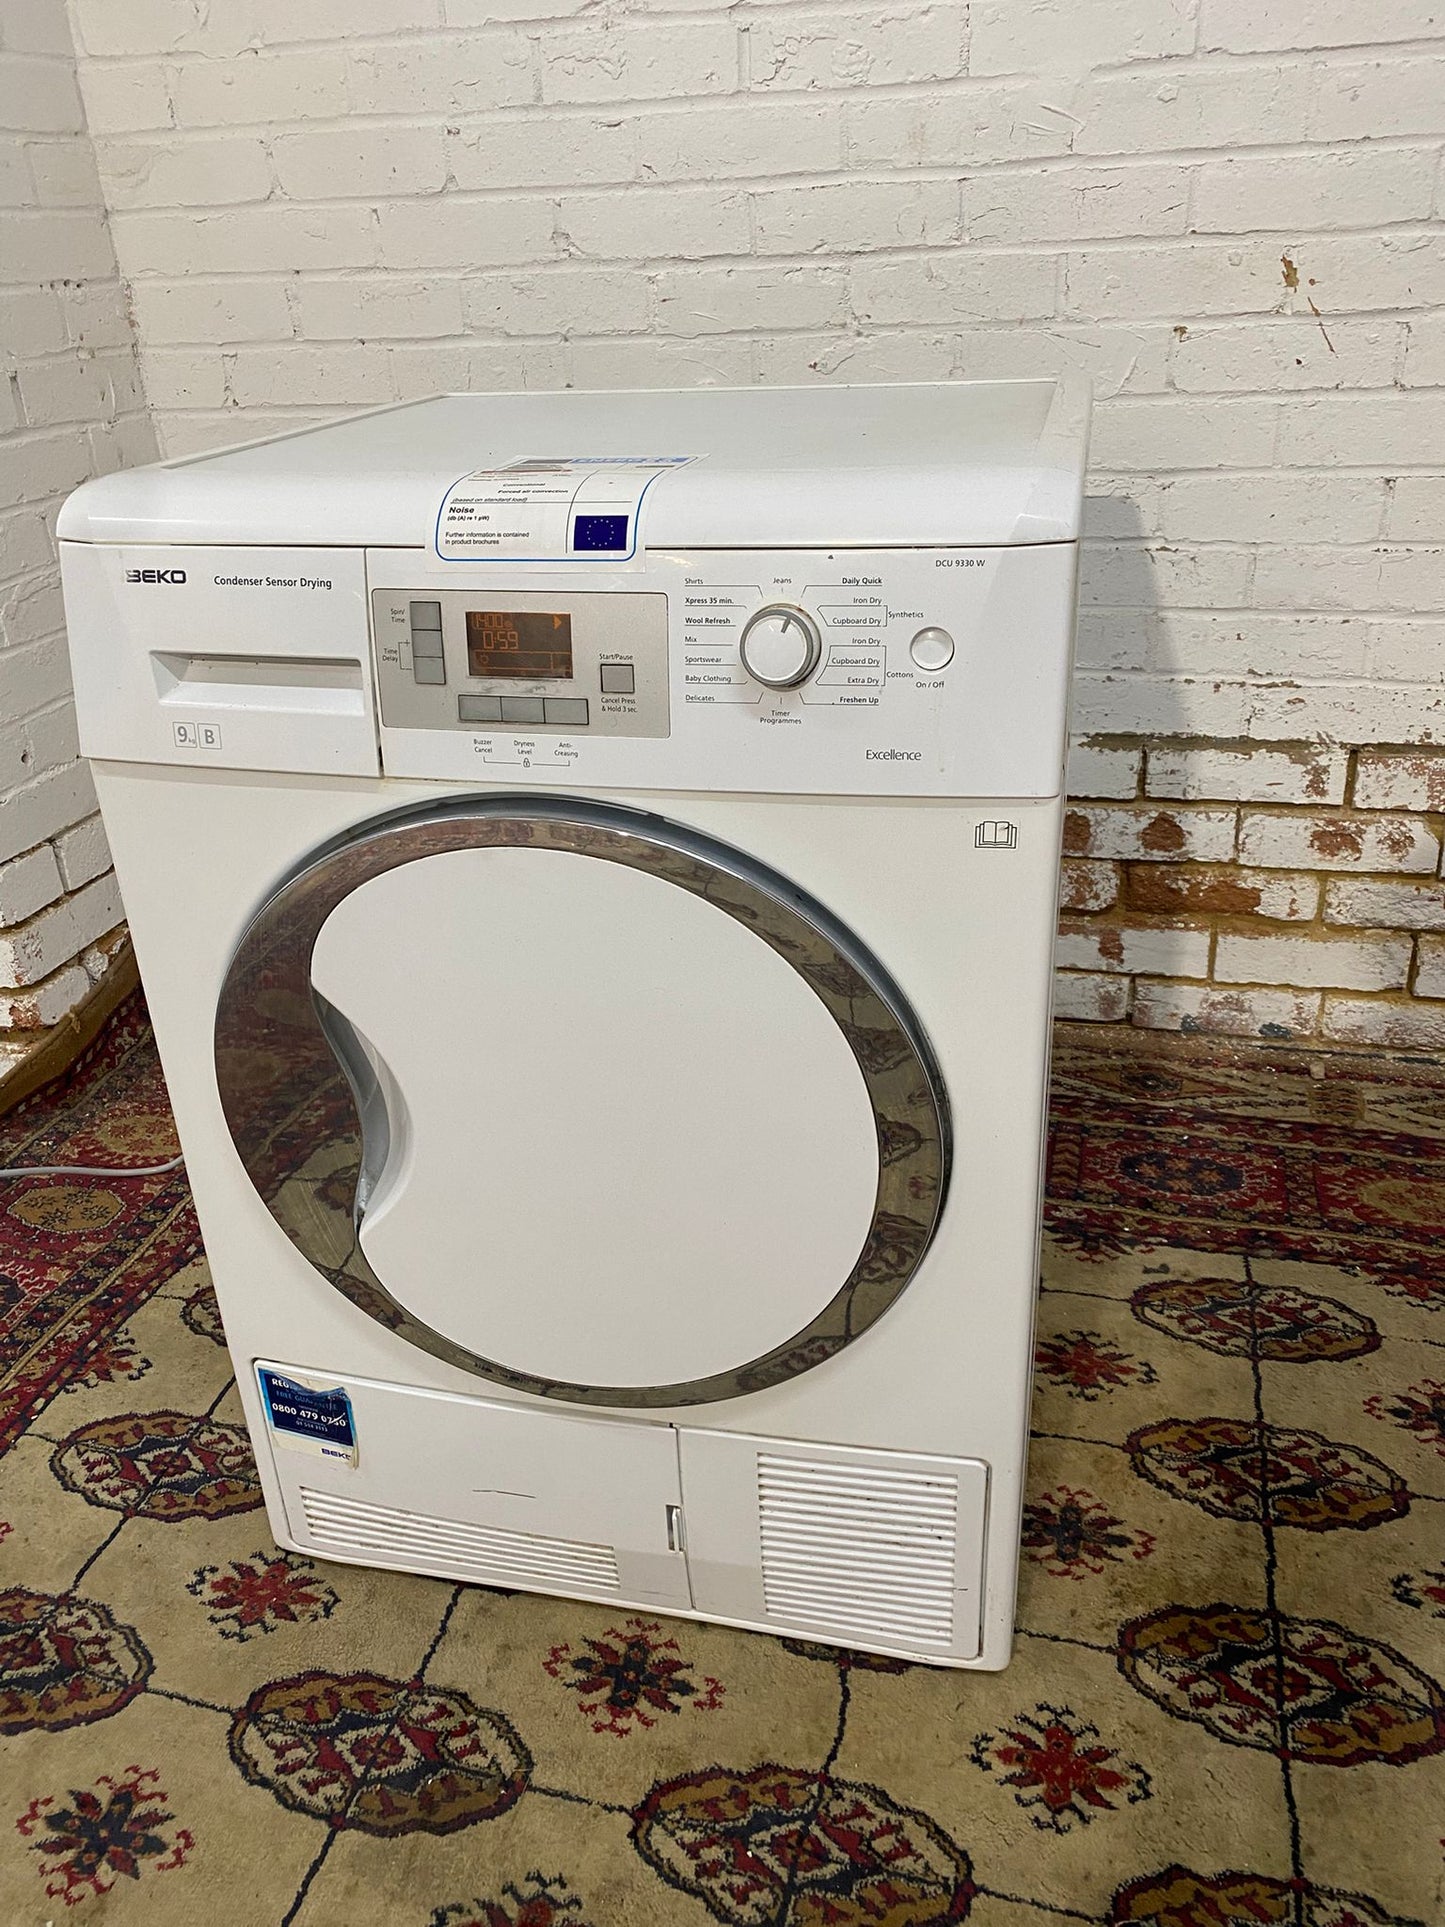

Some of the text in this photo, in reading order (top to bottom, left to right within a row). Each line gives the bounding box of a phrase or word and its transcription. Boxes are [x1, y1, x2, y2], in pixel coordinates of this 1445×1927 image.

[935, 559, 953, 567] DCU
[955, 559, 975, 567] 9330
[125, 569, 187, 584] BEKO
[213, 576, 333, 590] Condenser Sensor Drying
[842, 577, 883, 586] Daily Quick
[685, 597, 708, 605] Xpress
[869, 597, 883, 606] Dry
[888, 611, 924, 619] Synthetics
[832, 618, 882, 626] Cupboard Dry
[868, 638, 881, 646] Dry
[382, 655, 398, 663] Delay
[599, 653, 633, 661] Start/Pause
[684, 656, 722, 664] Sportswear
[831, 657, 881, 666] Cupboard Dry
[685, 675, 732, 683] Baby Clothing
[886, 671, 914, 679] Cottons
[866, 677, 880, 686] Dry
[932, 681, 945, 689] Off
[839, 696, 879, 706] Freshen Up
[760, 717, 802, 726] Programmes
[177, 726, 188, 743] 9
[204, 729, 215, 744] B
[513, 740, 536, 748] Dryness
[554, 749, 579, 759] Creasing
[866, 749, 922, 761] Excellence
[271, 1402, 297, 1415] 0800
[299, 1410, 319, 1420] 479
